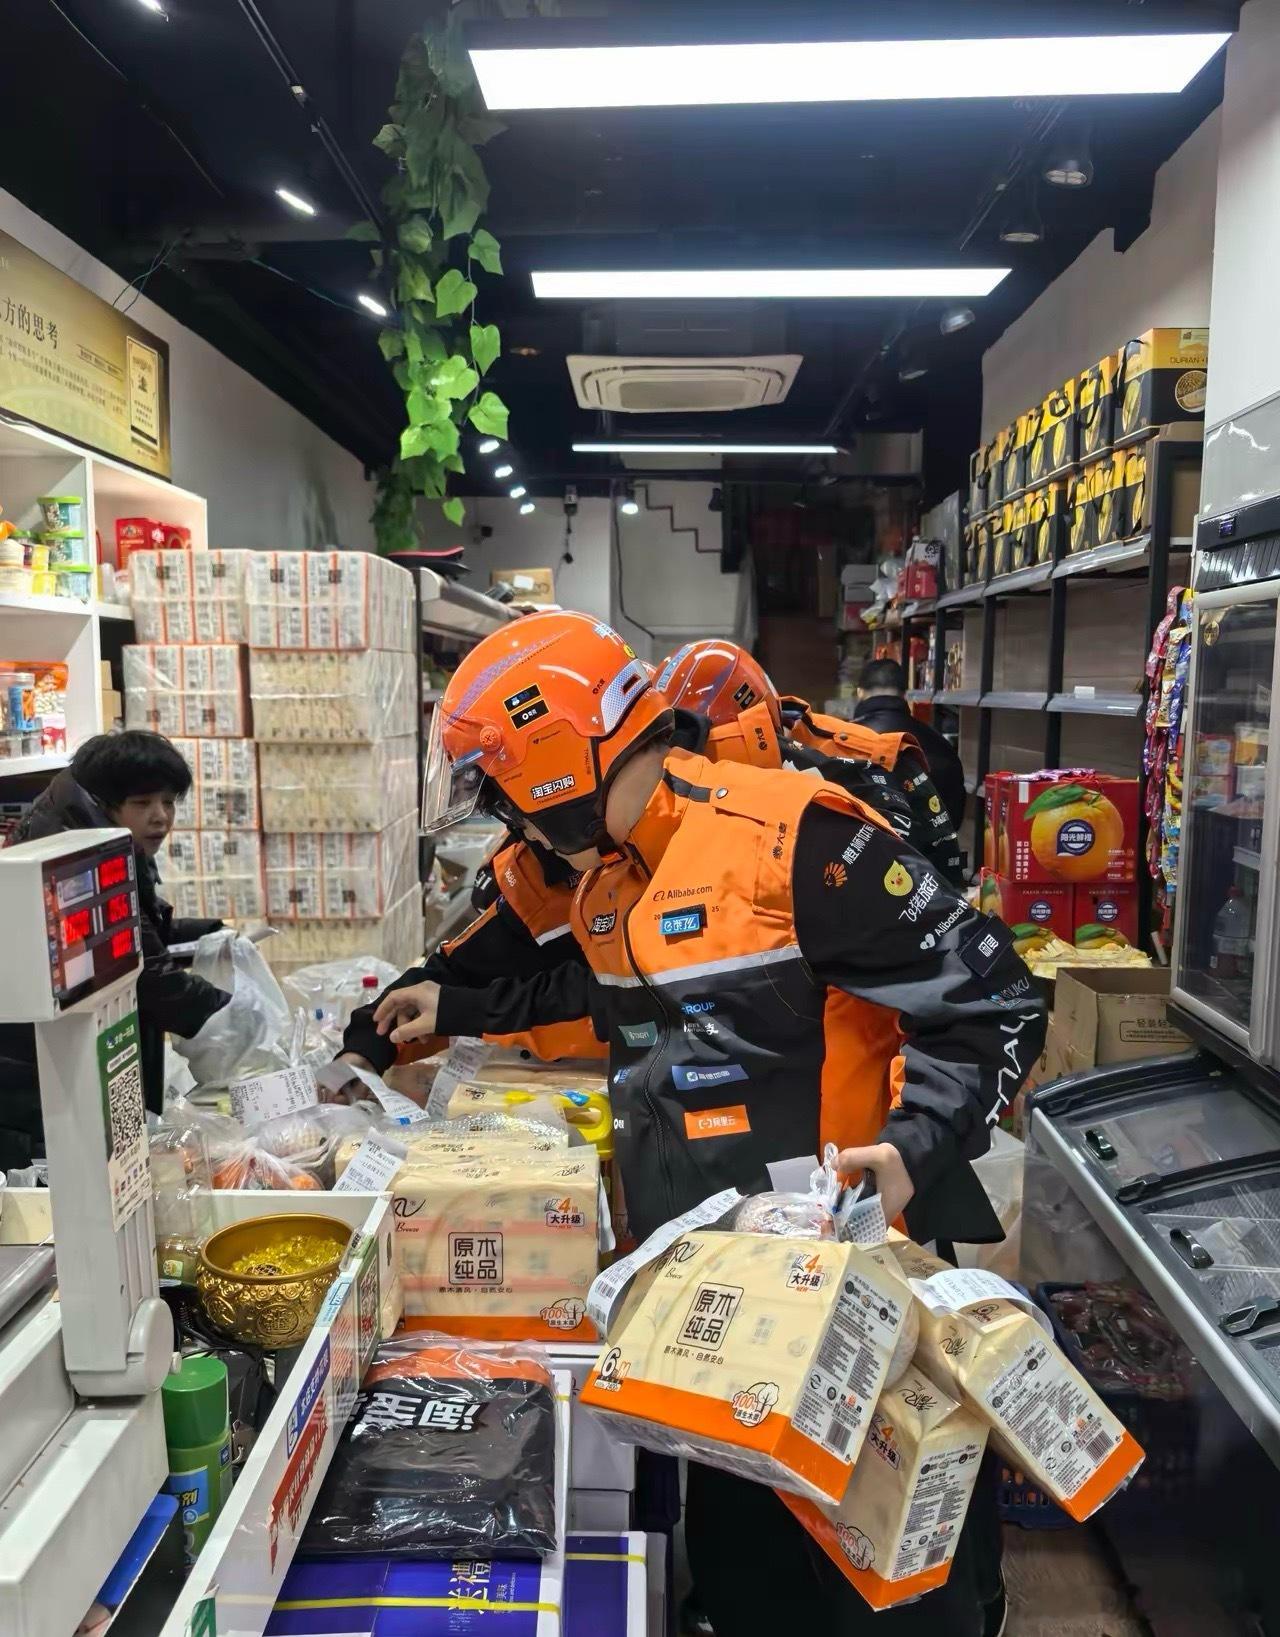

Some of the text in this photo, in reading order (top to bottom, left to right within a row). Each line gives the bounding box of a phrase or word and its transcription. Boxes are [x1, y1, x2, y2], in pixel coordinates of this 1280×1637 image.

[3, 297, 57, 349] 方的思考
[531, 775, 575, 800] 淘宝闪购
[666, 885, 713, 900] Alibaba.com
[899, 872, 939, 923] 飞猪旅行
[934, 904, 964, 937] Alibaba
[395, 1221, 420, 1233] Breeze
[550, 1214, 581, 1225] 大升级
[454, 1237, 497, 1257] 原木
[454, 1260, 497, 1280] 纯品
[791, 1274, 820, 1287] 大升级
[694, 1288, 736, 1317] 原木
[683, 1315, 724, 1343] 纯品
